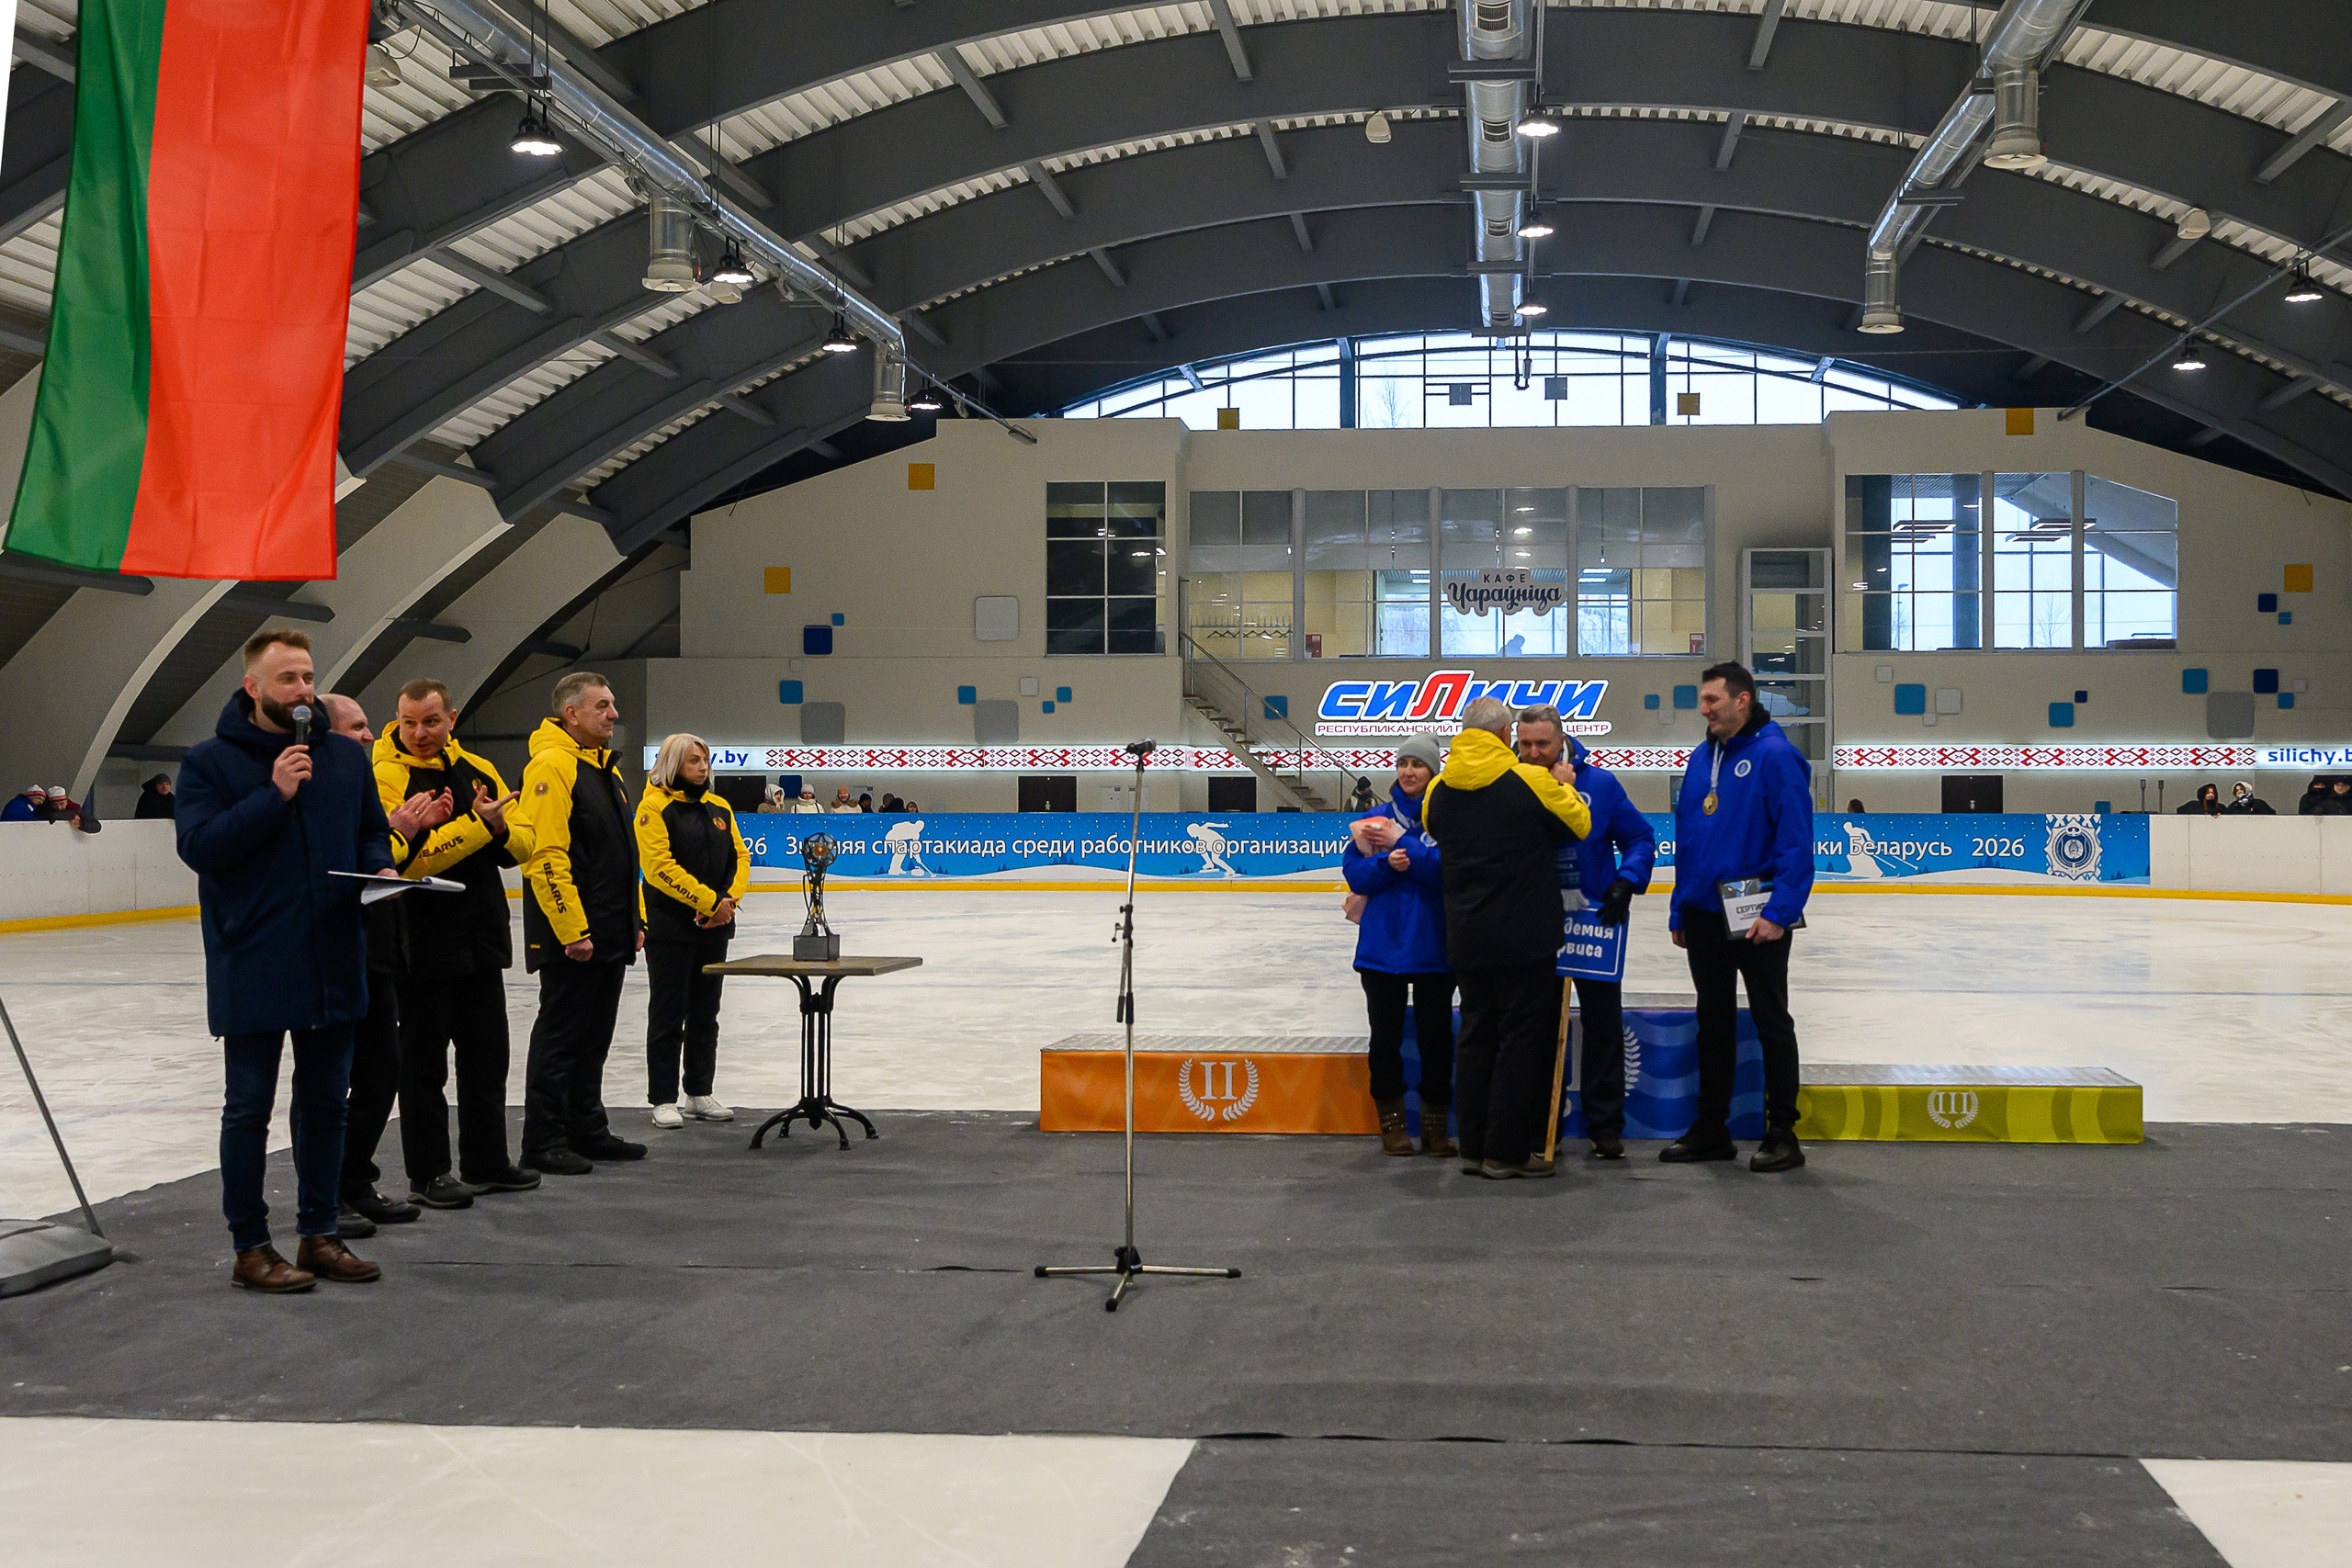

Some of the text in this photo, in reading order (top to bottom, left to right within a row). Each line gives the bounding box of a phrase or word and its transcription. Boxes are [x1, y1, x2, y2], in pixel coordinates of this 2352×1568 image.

[1484, 574, 1526, 583] КАФЕ
[1317, 724, 1453, 734] РЕСПУБЛИКАНСКИЙ
[1566, 724, 1609, 734] ЦЕНТР
[2267, 748, 2352, 765] silichy.b
[743, 837, 768, 856] 26
[872, 840, 1006, 858] спартакиада
[1012, 840, 1075, 858] среди
[1081, 833, 1208, 859] работников
[1211, 835, 1351, 859] организаций
[1849, 835, 1953, 860] Беларусь
[1971, 837, 2025, 857] 2026
[543, 862, 568, 914] BELARUS
[657, 870, 700, 905] BELARUS
[1564, 917, 1614, 940] демия
[1199, 1061, 1238, 1100] II
[1936, 1091, 1971, 1114] III
